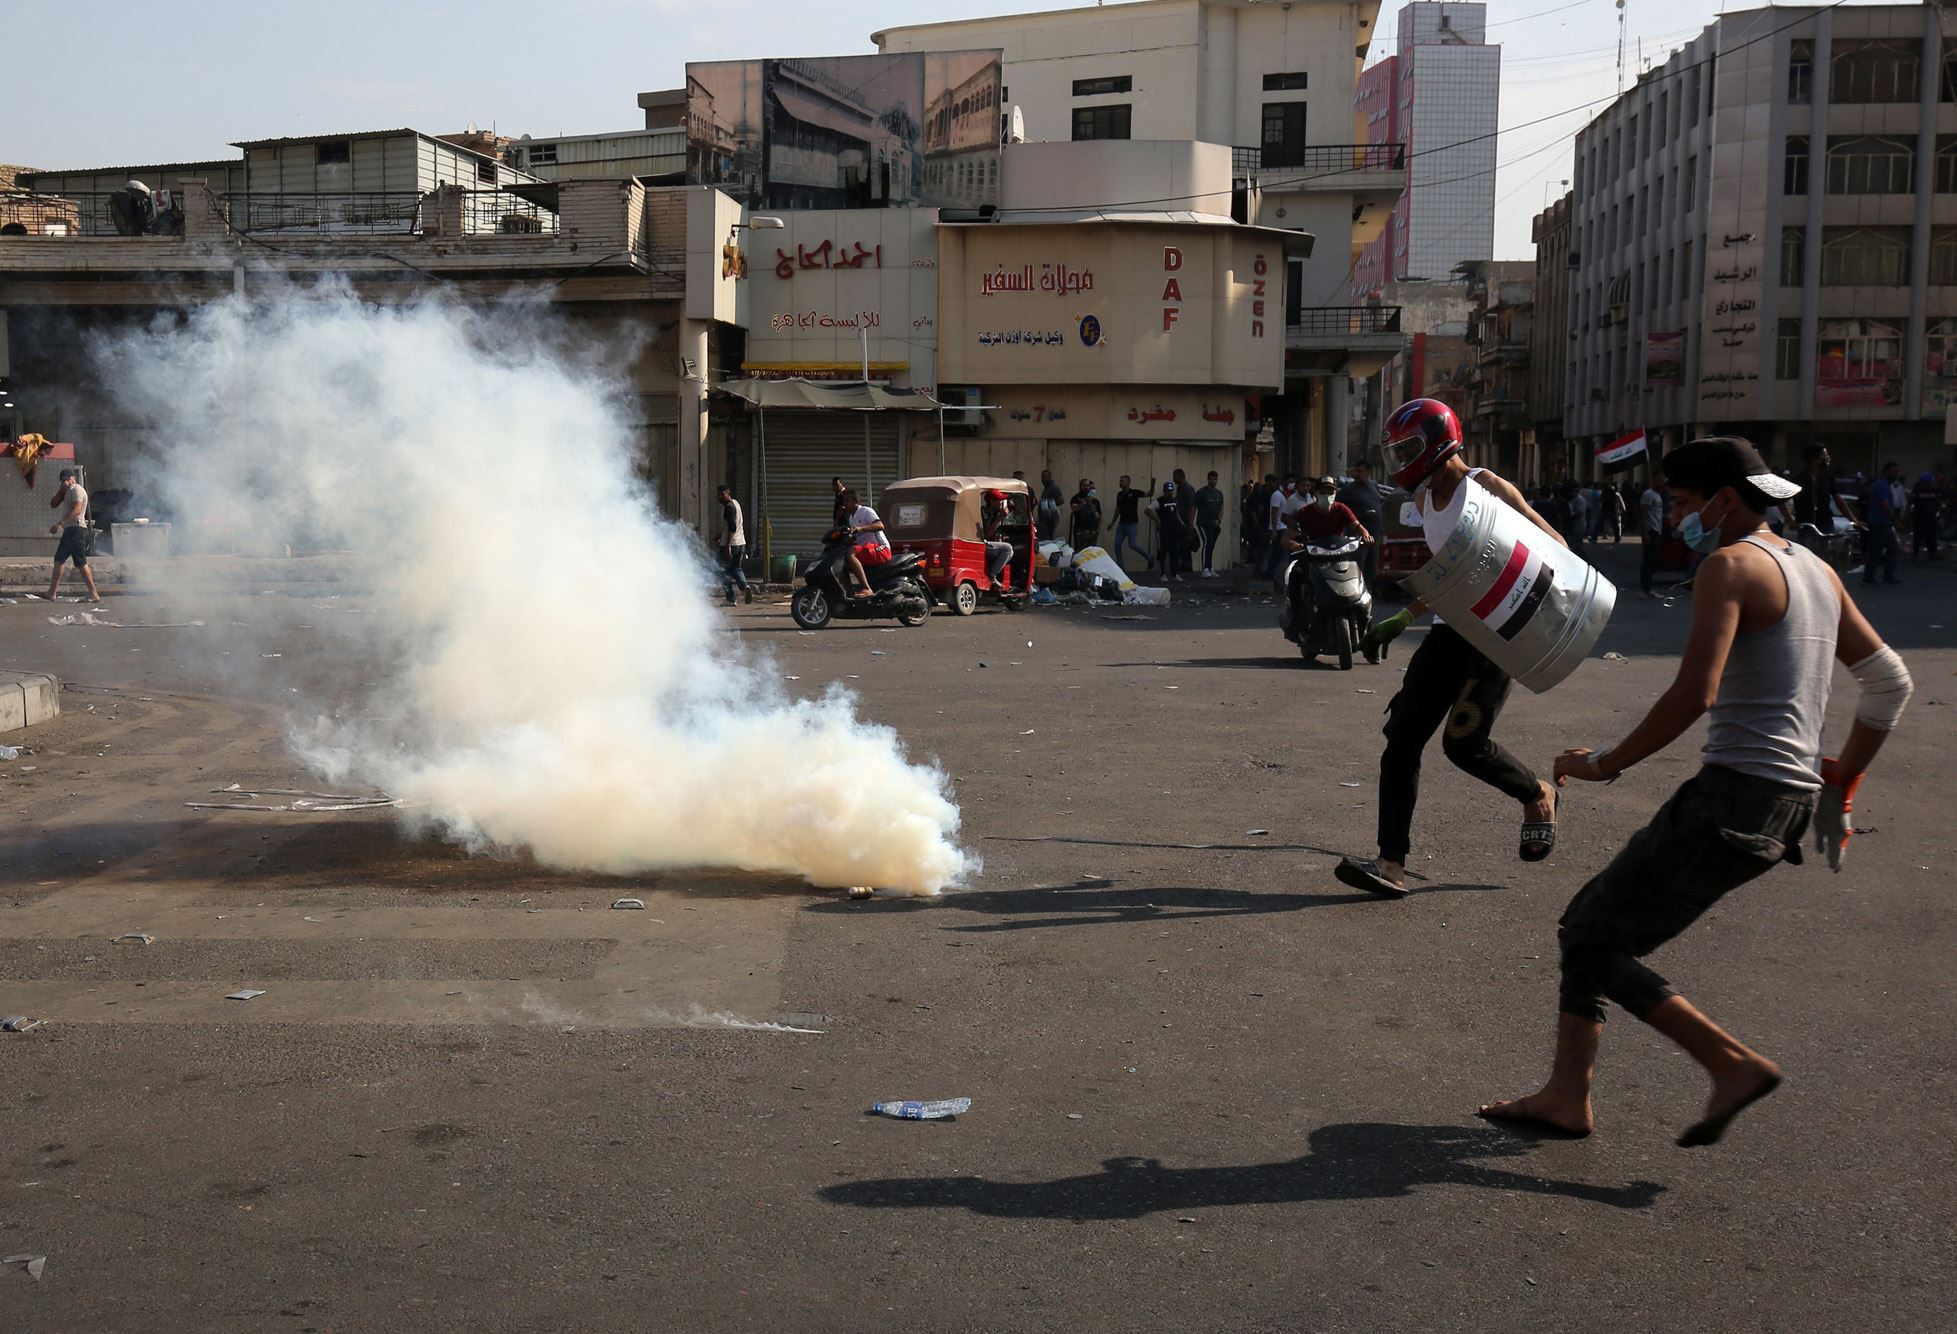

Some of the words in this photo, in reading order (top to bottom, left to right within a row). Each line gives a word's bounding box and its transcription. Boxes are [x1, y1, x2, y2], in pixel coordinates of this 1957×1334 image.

[981, 263, 1035, 297] السفير
[1040, 263, 1094, 297] محلات
[1714, 266, 1757, 283] الرشيد
[1162, 246, 1183, 333] DAF
[1715, 300, 1756, 315] التجاري
[978, 331, 1004, 346] التركية
[1023, 330, 1042, 345] شركة
[1044, 330, 1064, 346] وكيل
[1034, 406, 1046, 423] 7
[1127, 404, 1177, 425] مفرد
[1202, 403, 1235, 426] جملة
[1522, 830, 1549, 840] CR7
